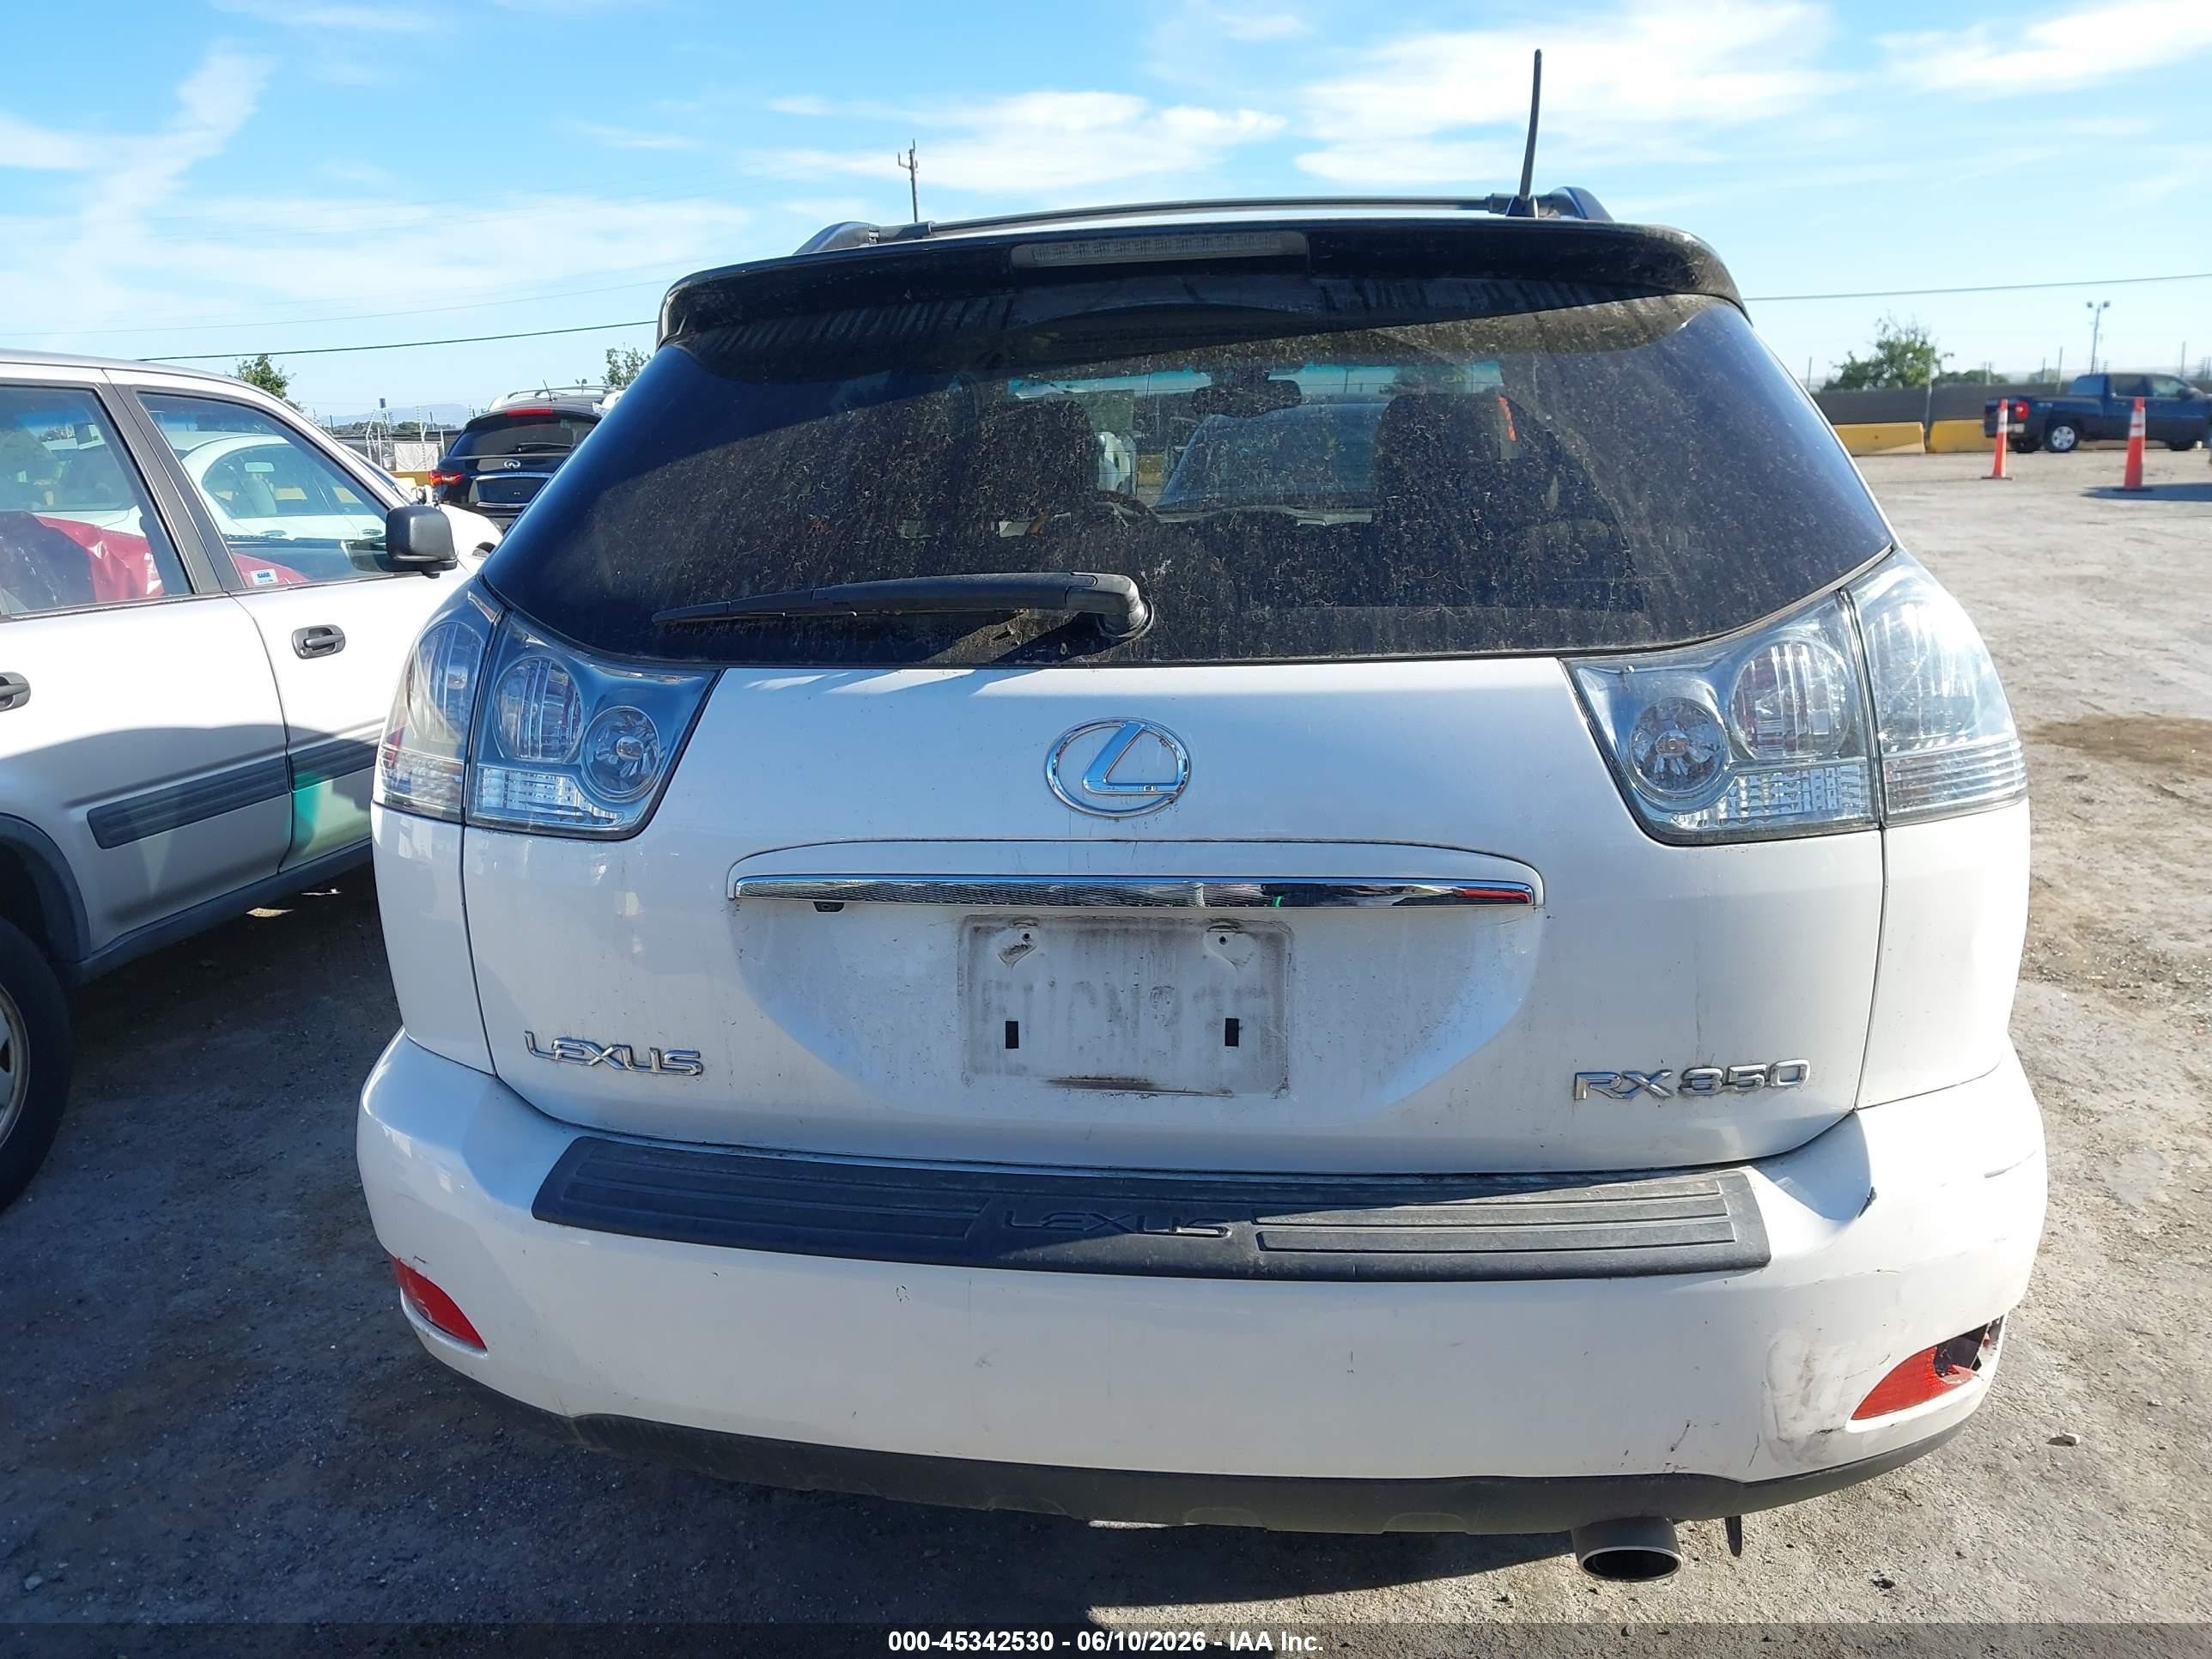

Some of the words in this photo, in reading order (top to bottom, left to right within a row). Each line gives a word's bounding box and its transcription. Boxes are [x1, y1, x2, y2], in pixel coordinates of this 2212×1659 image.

[524, 1030, 704, 1076] LEXUS
[1573, 1070, 1674, 1100] RX
[1679, 1058, 1812, 1097] 350
[1005, 1209, 1233, 1239] LEXUS
